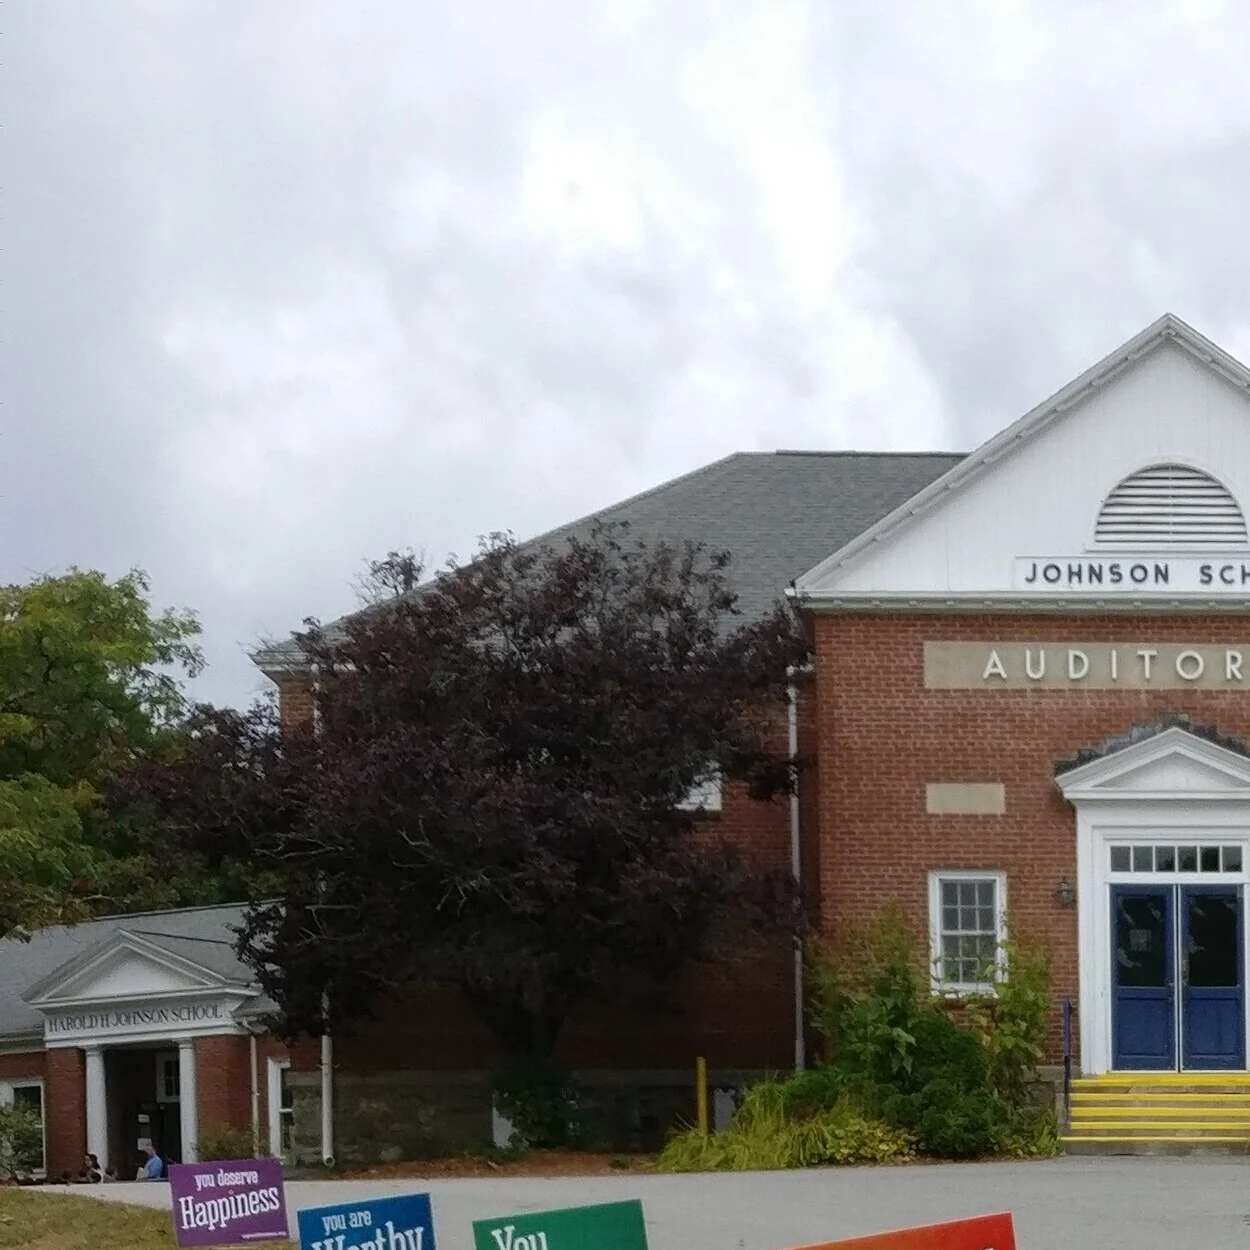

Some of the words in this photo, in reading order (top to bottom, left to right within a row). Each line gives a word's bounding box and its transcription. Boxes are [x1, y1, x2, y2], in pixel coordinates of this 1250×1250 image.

[1024, 563, 1170, 584] JOHNSON
[110, 1009, 169, 1026] JOHNSON
[171, 1004, 223, 1021] SCHOOL
[194, 1173, 216, 1192] you
[217, 1168, 259, 1187] deserve
[179, 1187, 280, 1231] Happiness
[322, 1214, 347, 1236] you
[349, 1210, 372, 1228] are
